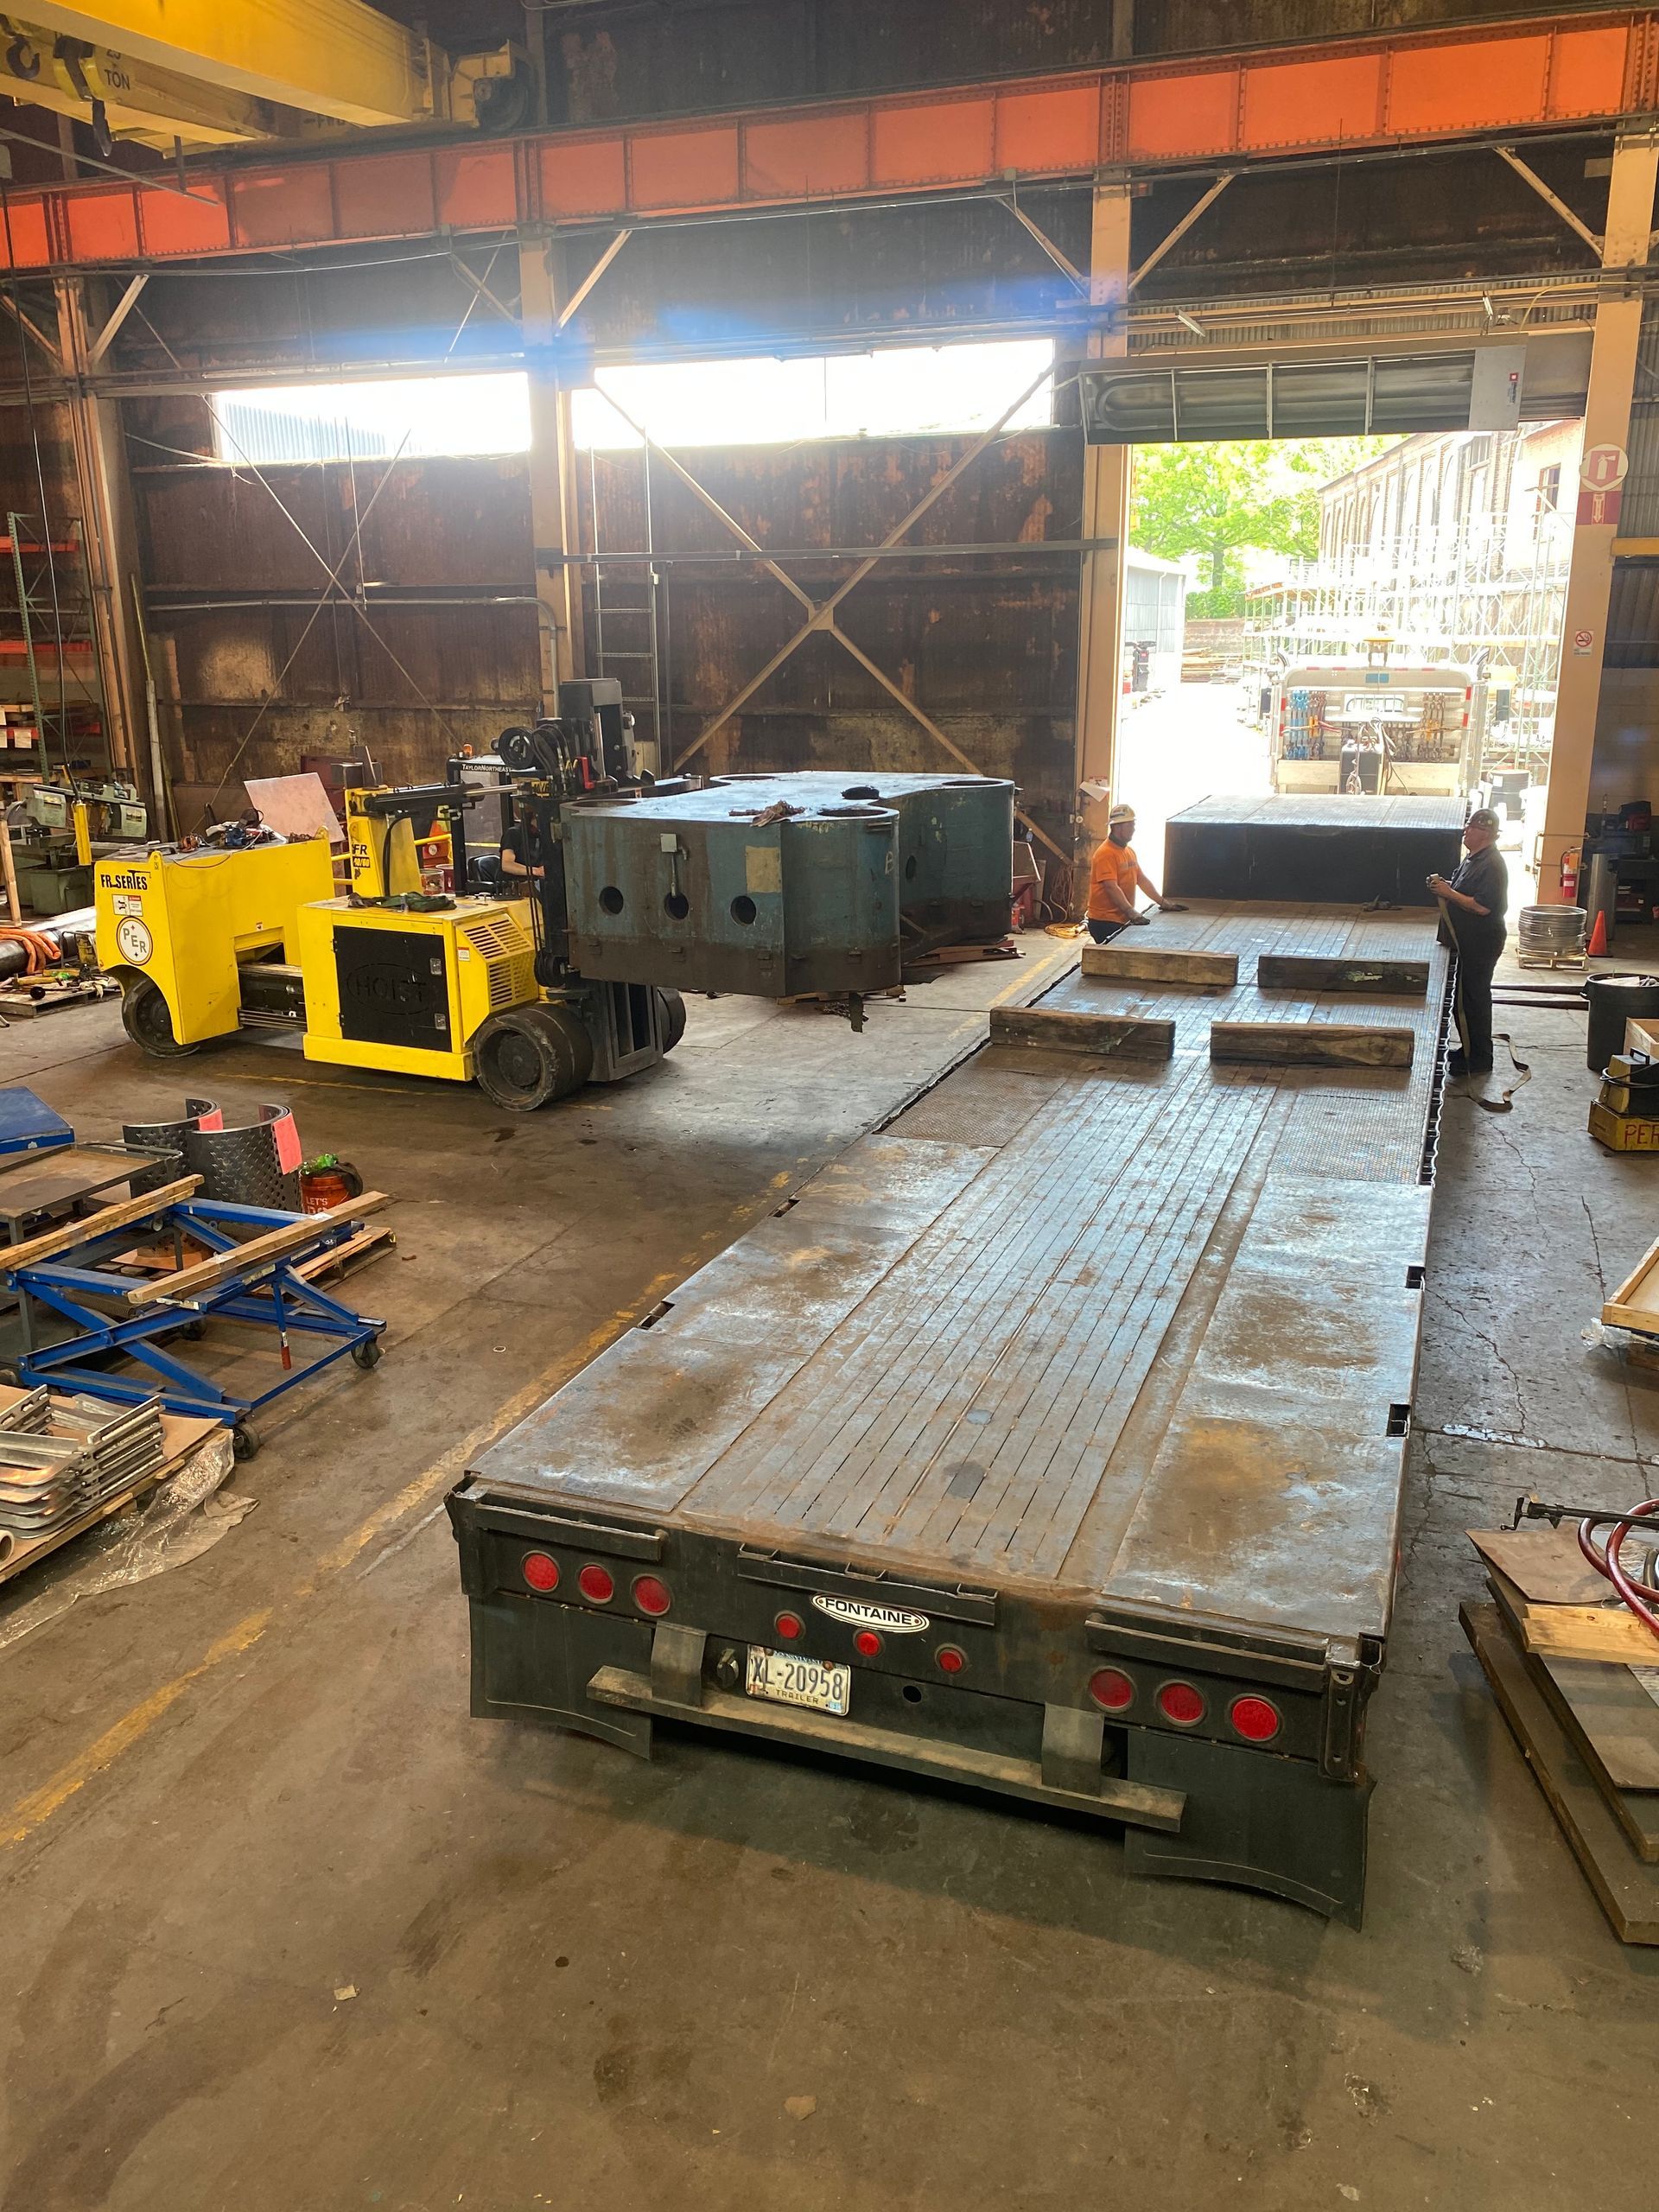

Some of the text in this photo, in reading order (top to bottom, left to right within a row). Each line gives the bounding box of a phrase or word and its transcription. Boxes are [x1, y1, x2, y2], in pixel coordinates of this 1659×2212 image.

[104, 69, 130, 90] TON
[352, 843, 367, 855] FR
[123, 928, 147, 953] PER
[356, 975, 427, 1003] HOIST
[306, 1196, 327, 1206] LET'S
[825, 1598, 912, 1624] FONTAINE
[753, 1656, 842, 1700] XL-20958
[776, 1689, 819, 1705] TRAILER
